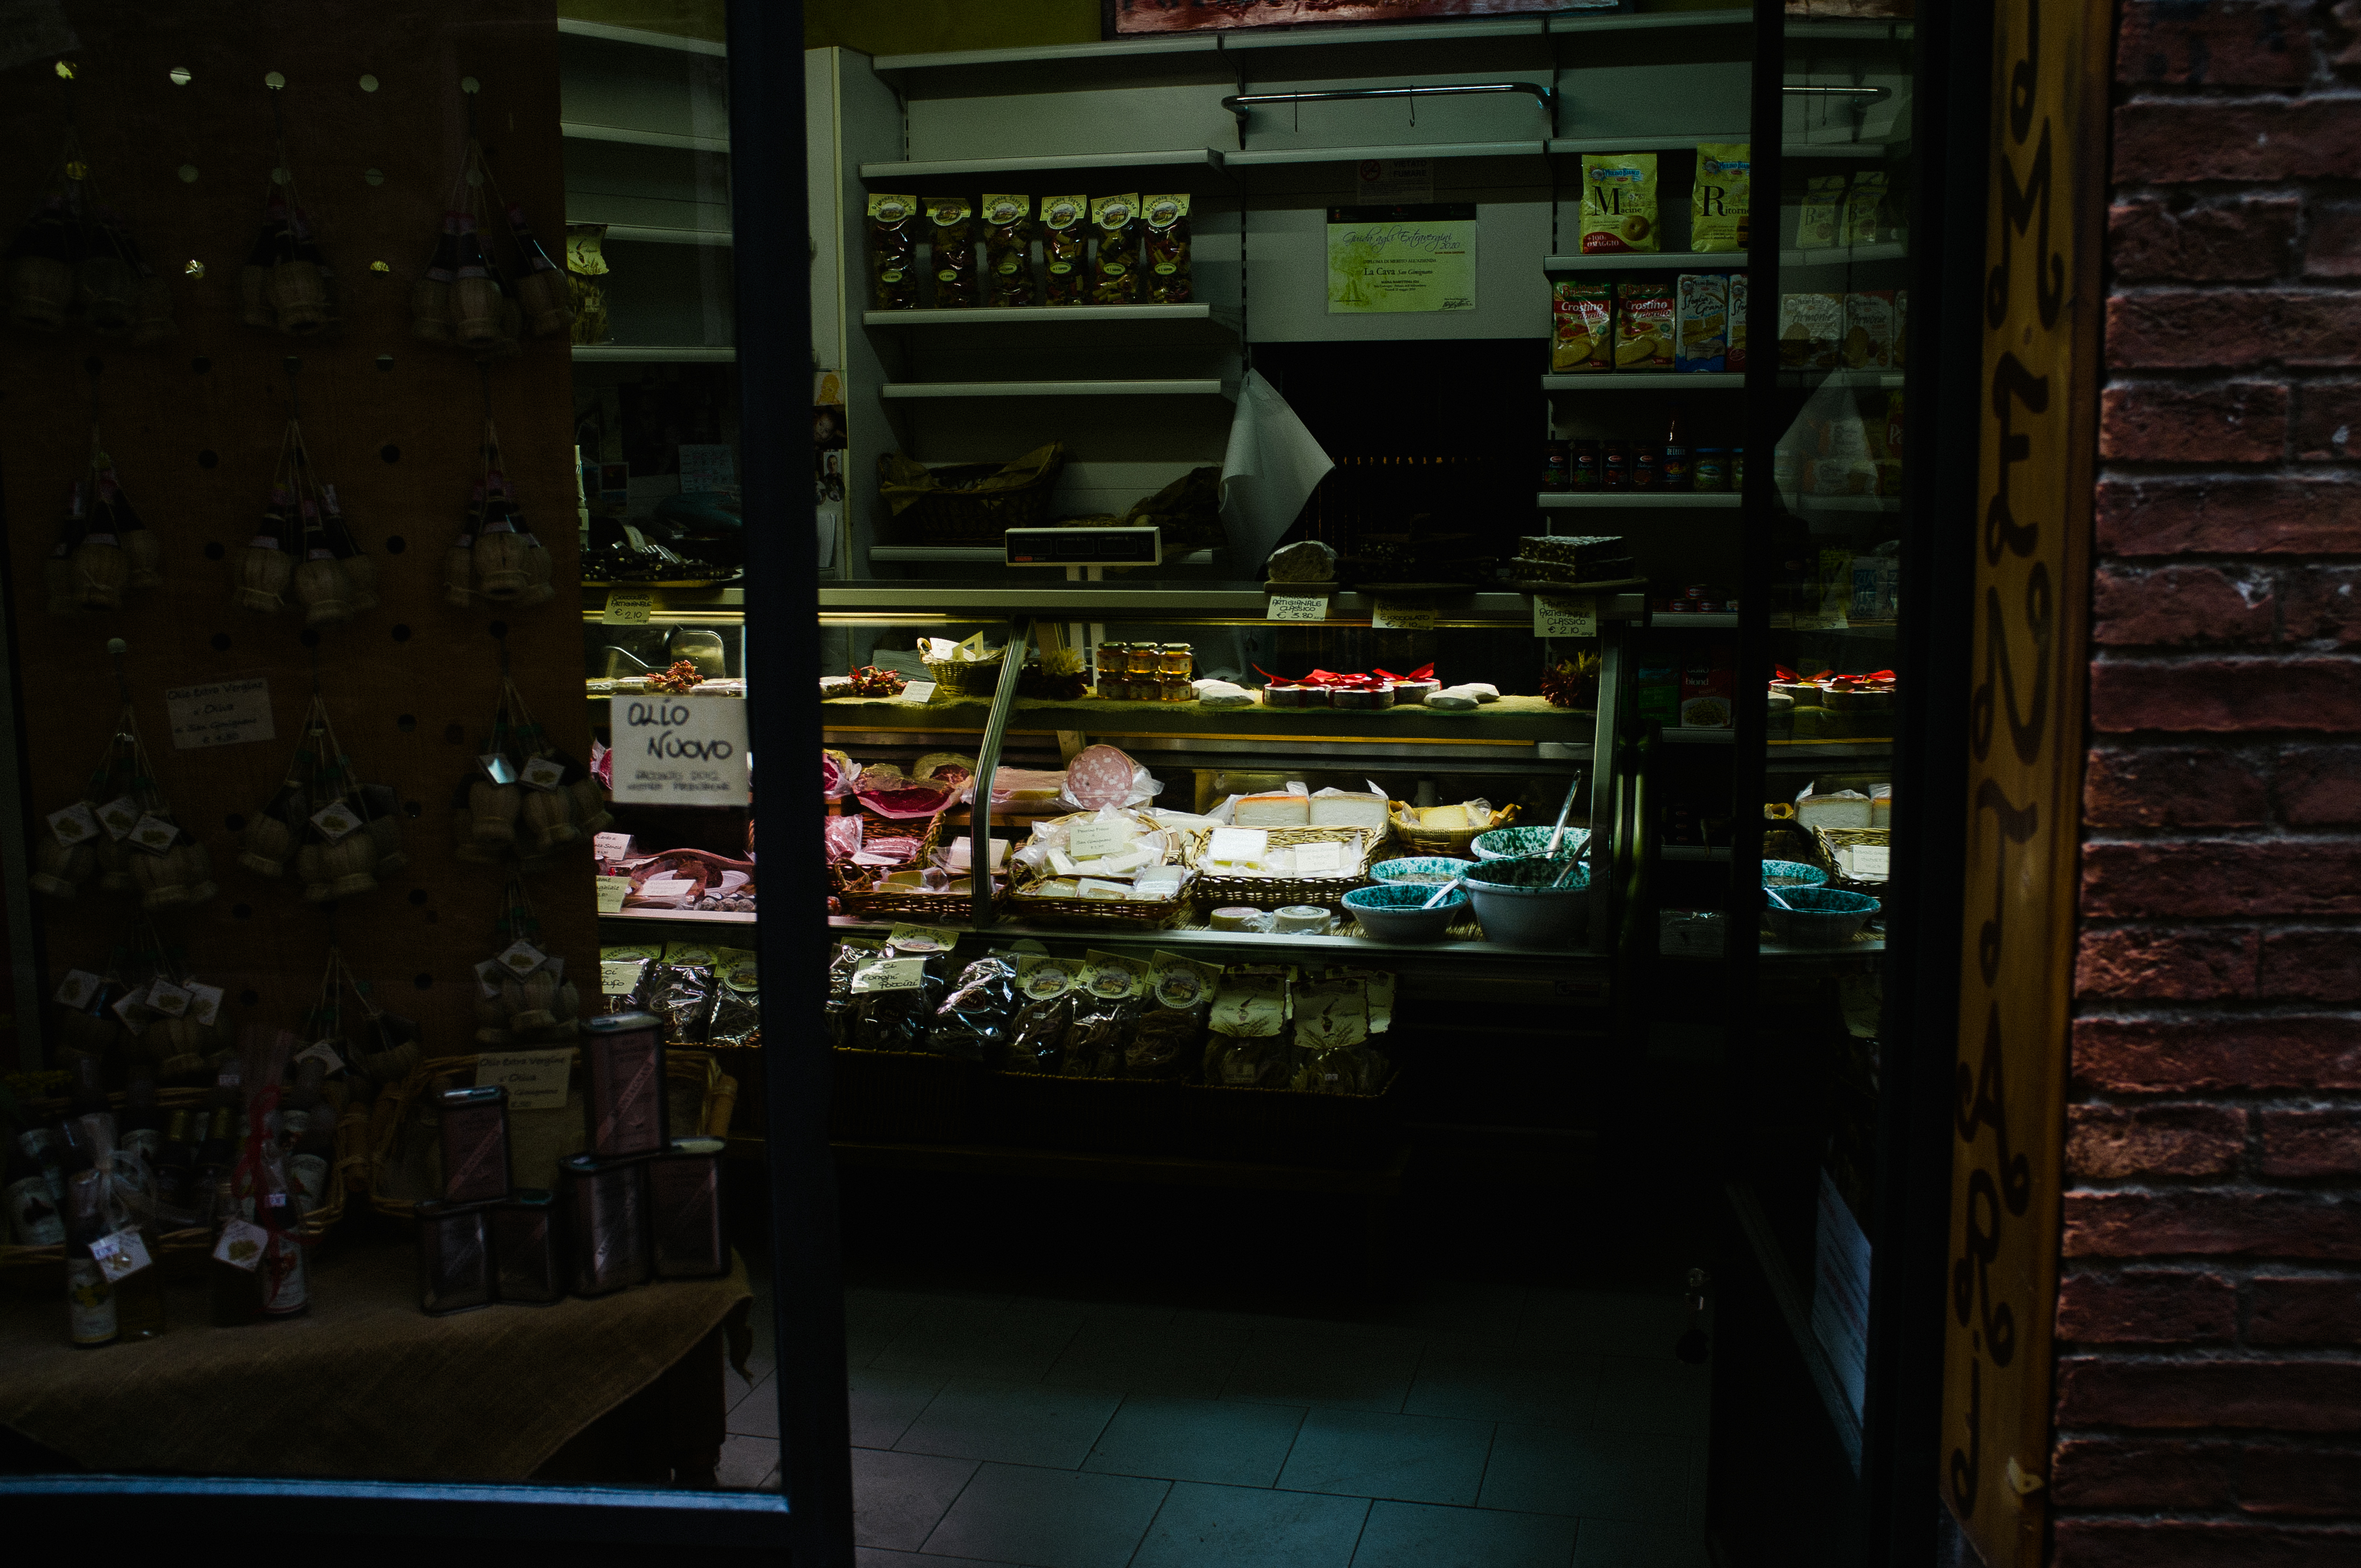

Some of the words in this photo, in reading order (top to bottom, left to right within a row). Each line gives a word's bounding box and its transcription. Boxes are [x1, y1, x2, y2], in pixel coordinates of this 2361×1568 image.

[1343, 226, 1381, 247] Guida
[1372, 225, 1402, 253] agli
[1398, 228, 1452, 253] Extravergini
[1563, 284, 1604, 297] Buitoni
[1625, 283, 1668, 296] Buitoni
[1561, 301, 1604, 312] Crostino
[1626, 300, 1668, 311] Crostino
[1695, 302, 1723, 317] Grano
[624, 611, 643, 619] 2.10
[1547, 618, 1586, 626] CLASSICO
[1685, 663, 1710, 673] Gallo
[221, 681, 263, 694] Vergine
[1685, 677, 1710, 686] blond
[628, 698, 689, 727] OLIO
[647, 730, 733, 762] NUOVO
[601, 978, 624, 989] tufo
